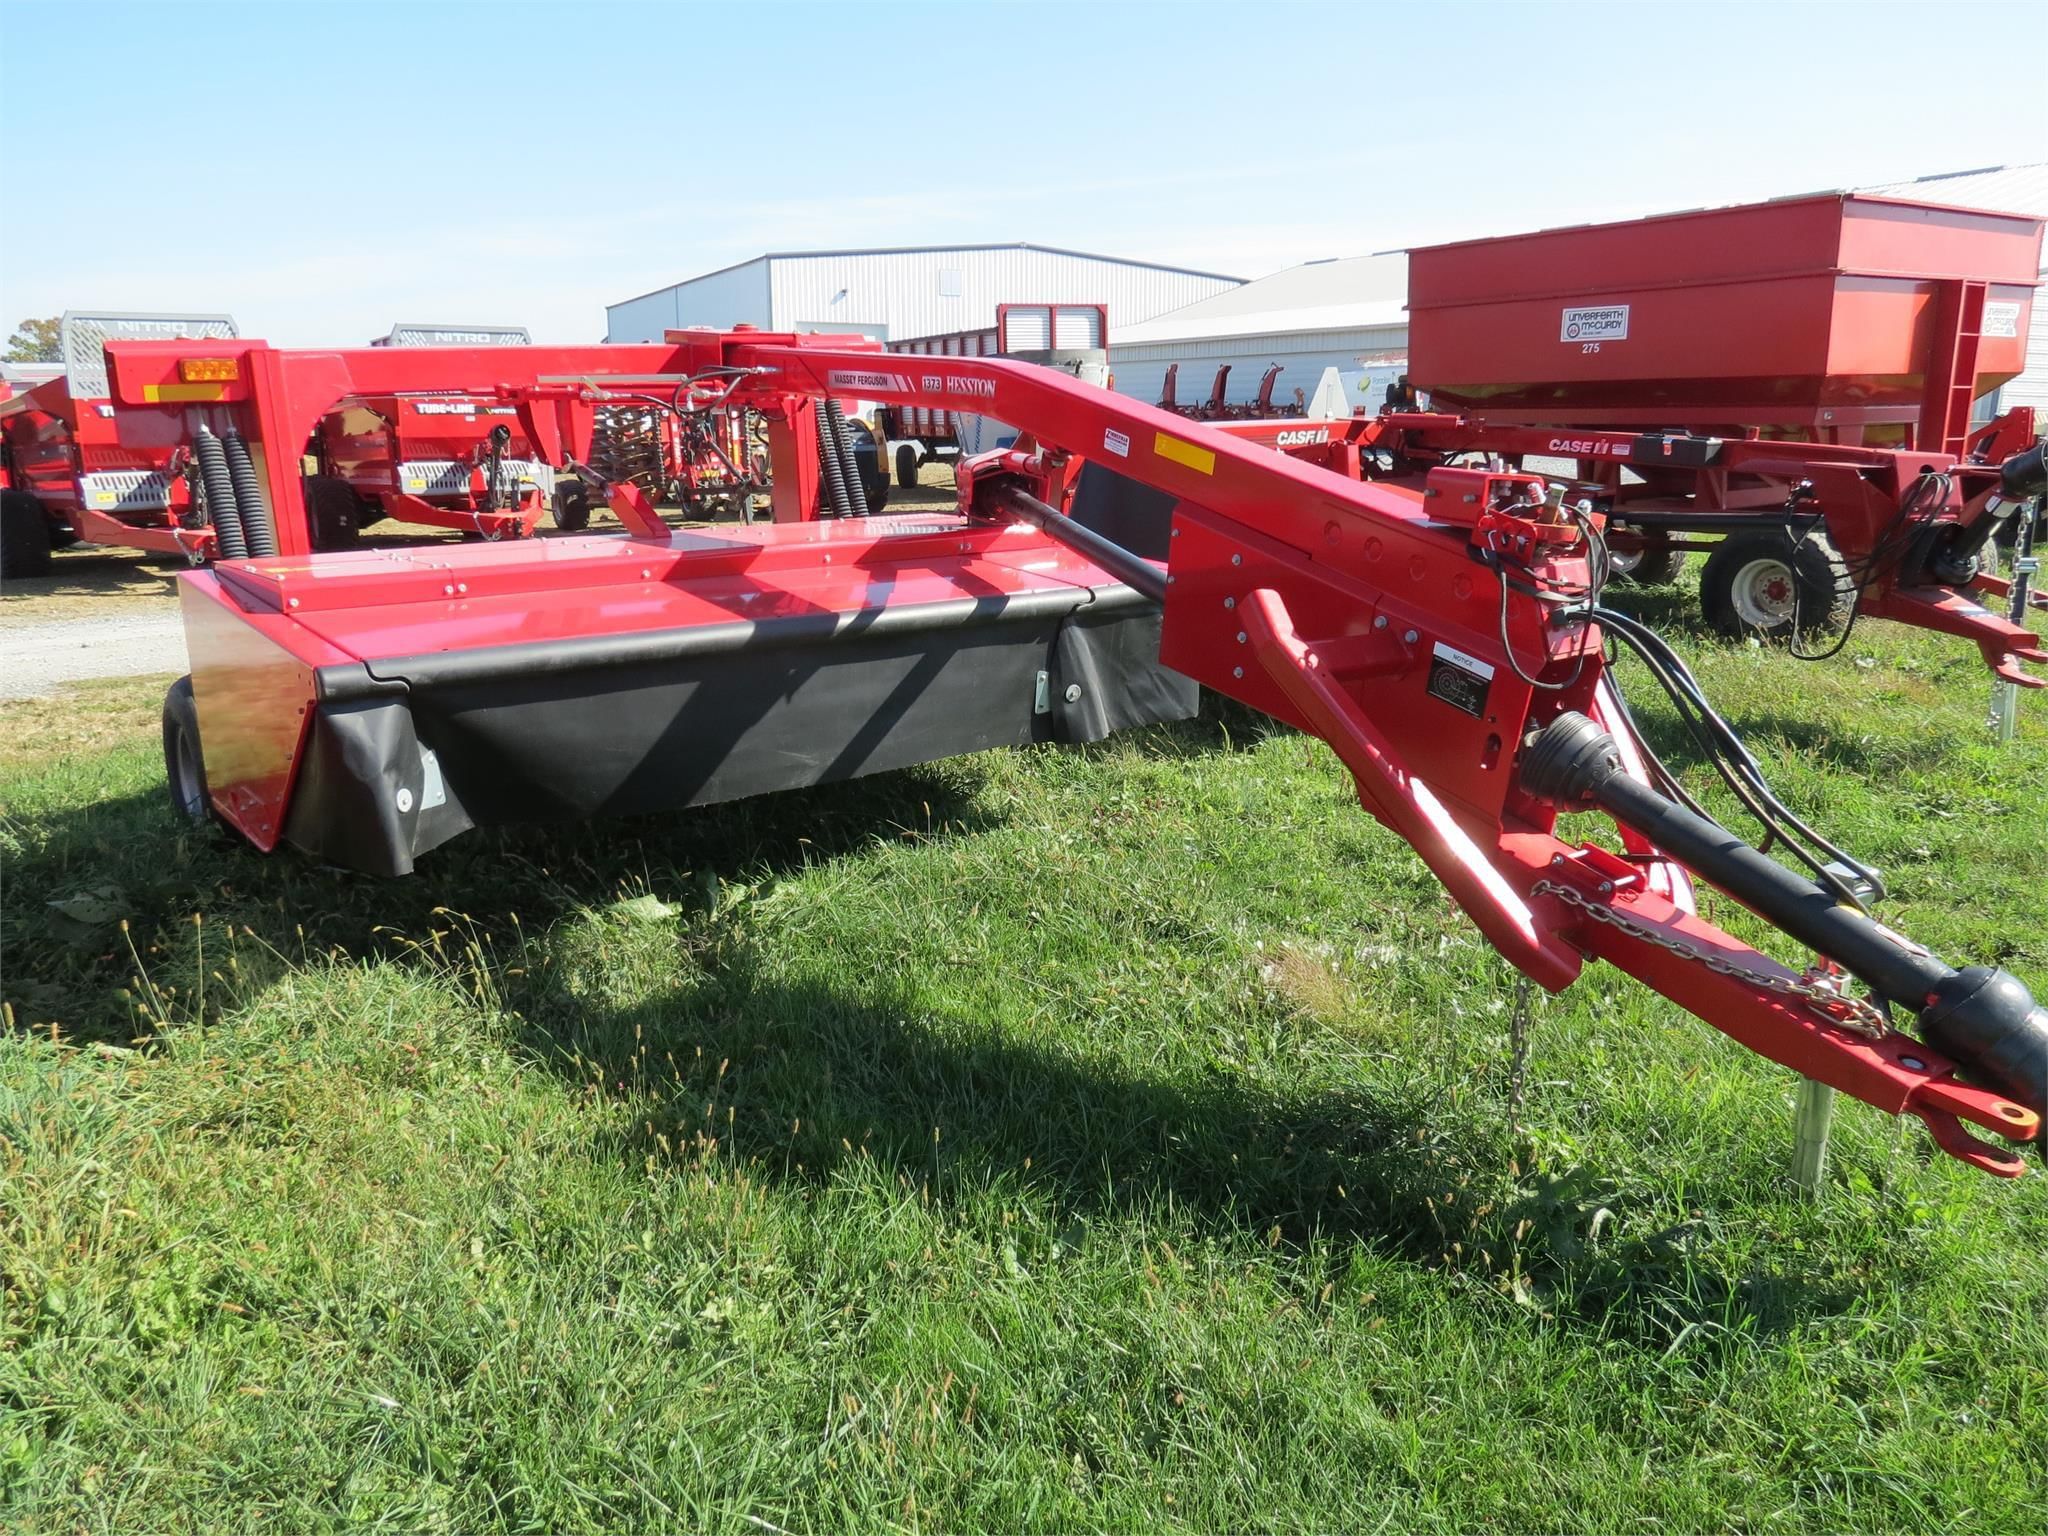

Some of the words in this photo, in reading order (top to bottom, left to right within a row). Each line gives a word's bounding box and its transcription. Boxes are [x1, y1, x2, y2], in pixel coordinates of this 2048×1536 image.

[117, 321, 188, 332] NITRO
[434, 332, 491, 343] NITRO
[1582, 343, 1600, 354] 275
[834, 374, 857, 385] MASSEY
[857, 375, 888, 386] FERGUSON
[923, 378, 941, 390] 1373
[947, 376, 997, 397] HESSTON
[1277, 430, 1316, 445] CASE
[1548, 439, 1593, 453] CASE
[1453, 654, 1473, 667] NOTICE
